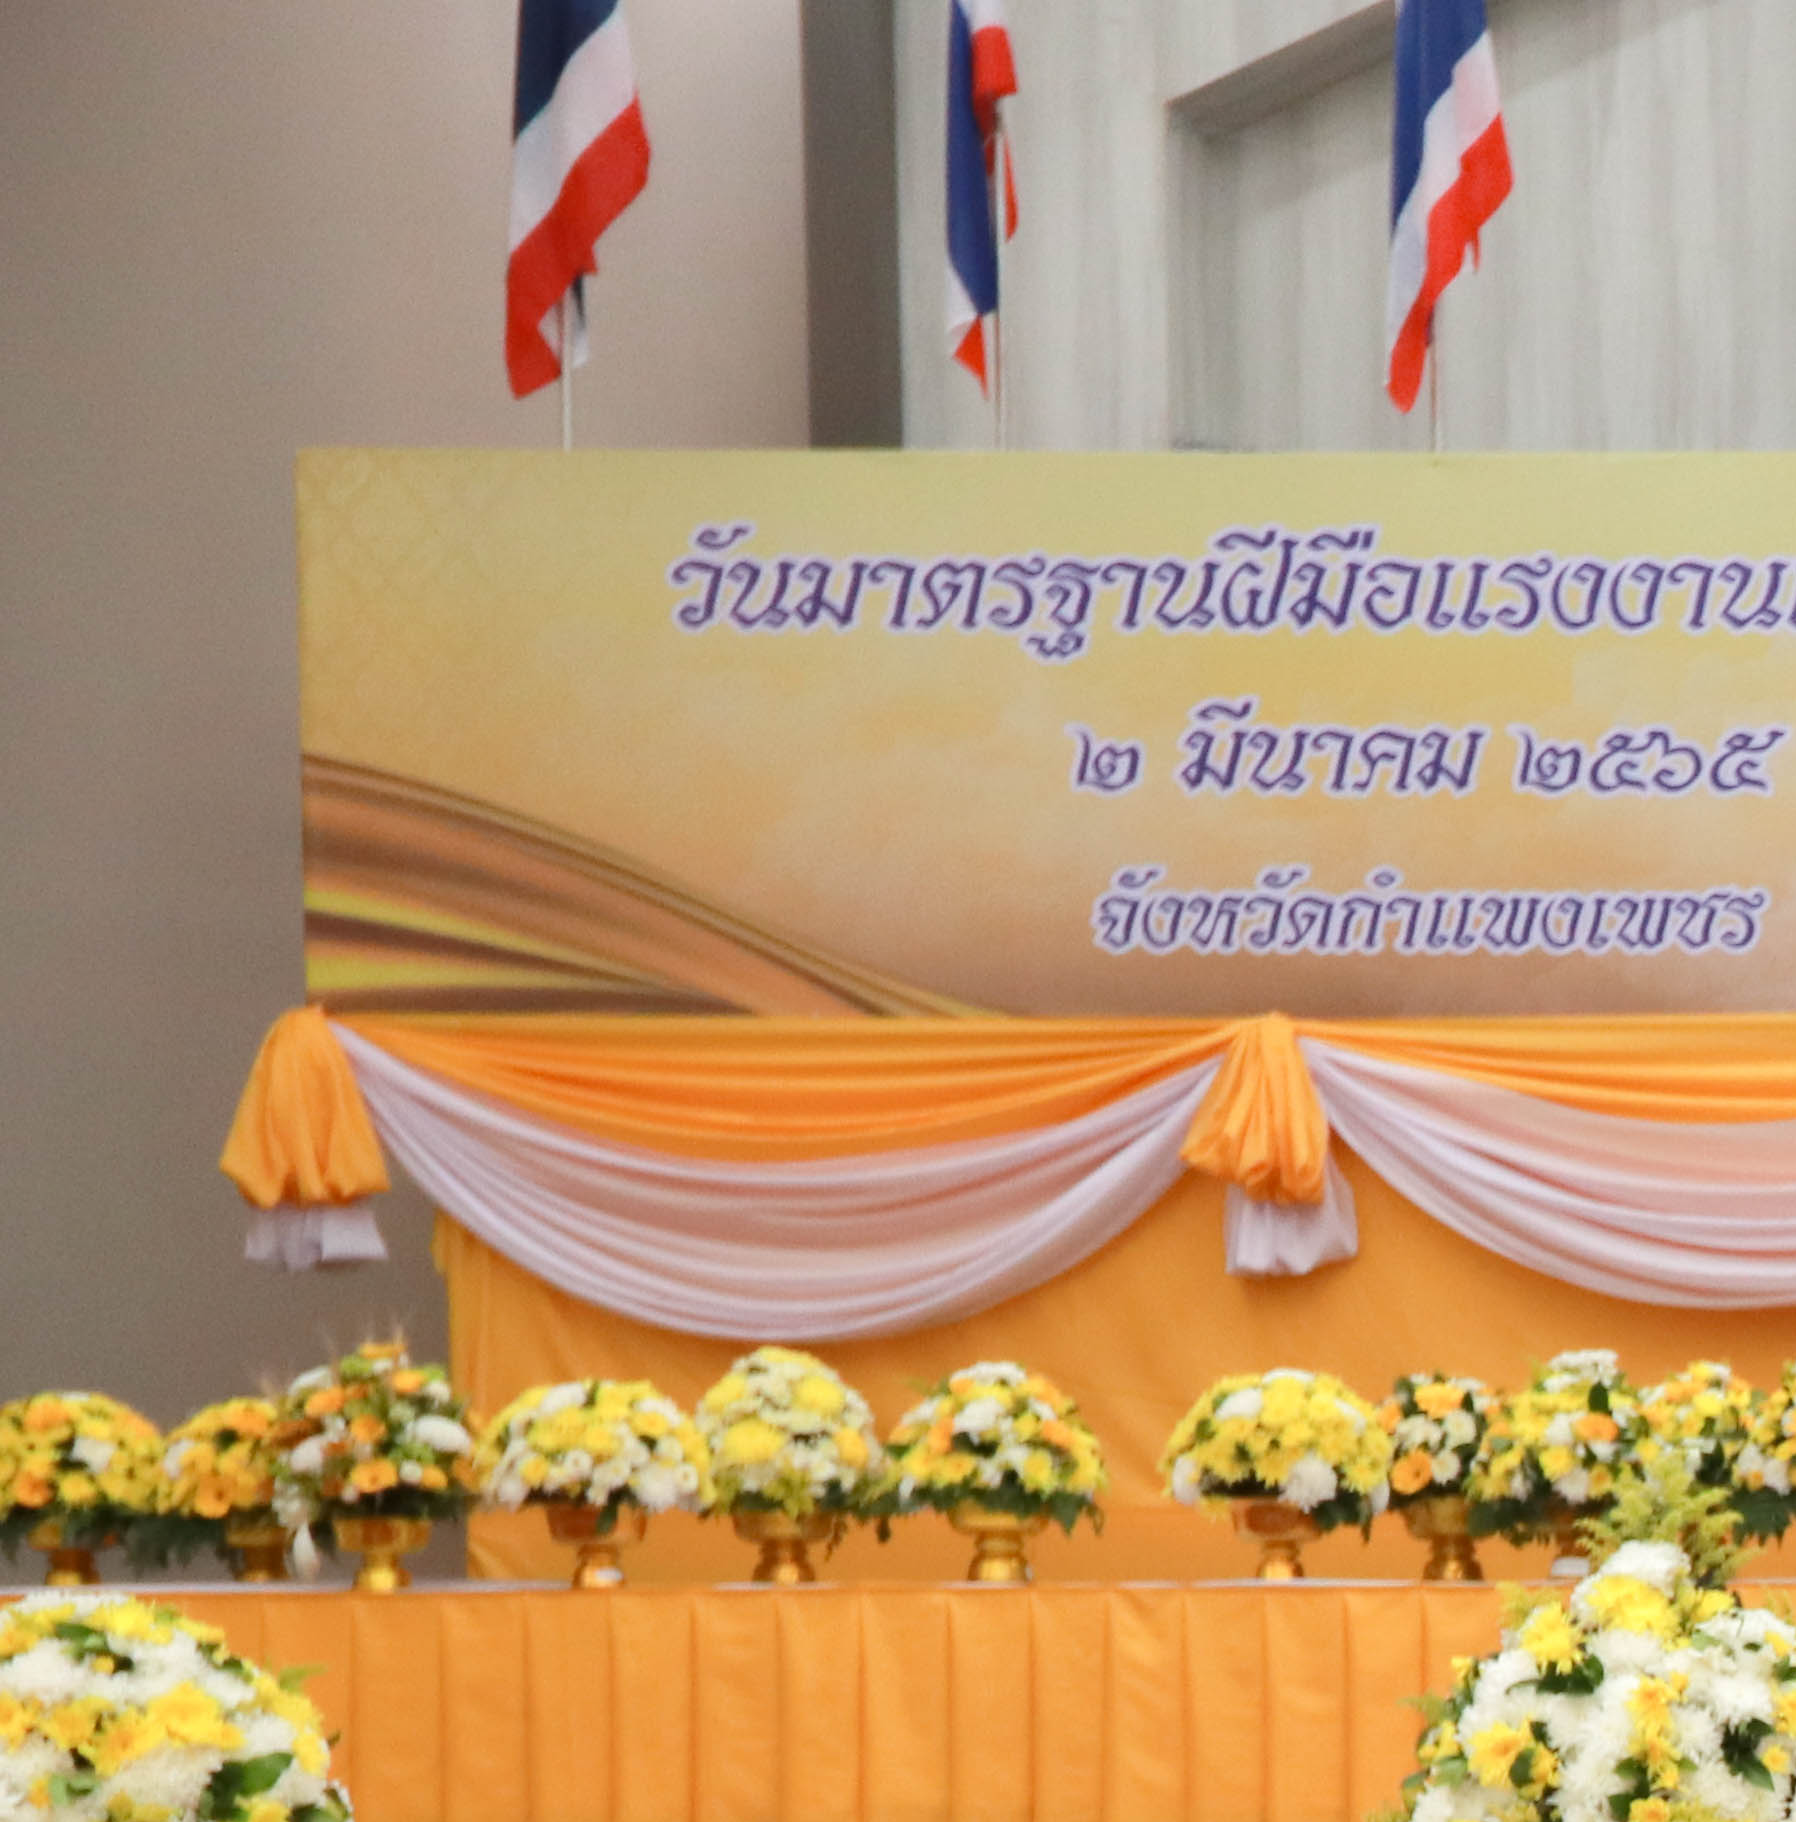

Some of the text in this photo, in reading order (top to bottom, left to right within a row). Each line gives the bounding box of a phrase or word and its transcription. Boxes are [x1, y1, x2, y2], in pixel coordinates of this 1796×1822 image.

[1074, 699, 1786, 795] ๒ มีนาคม ๒๕๖๕
[1095, 866, 1767, 952] จังหวัดกำแพงเพชร
